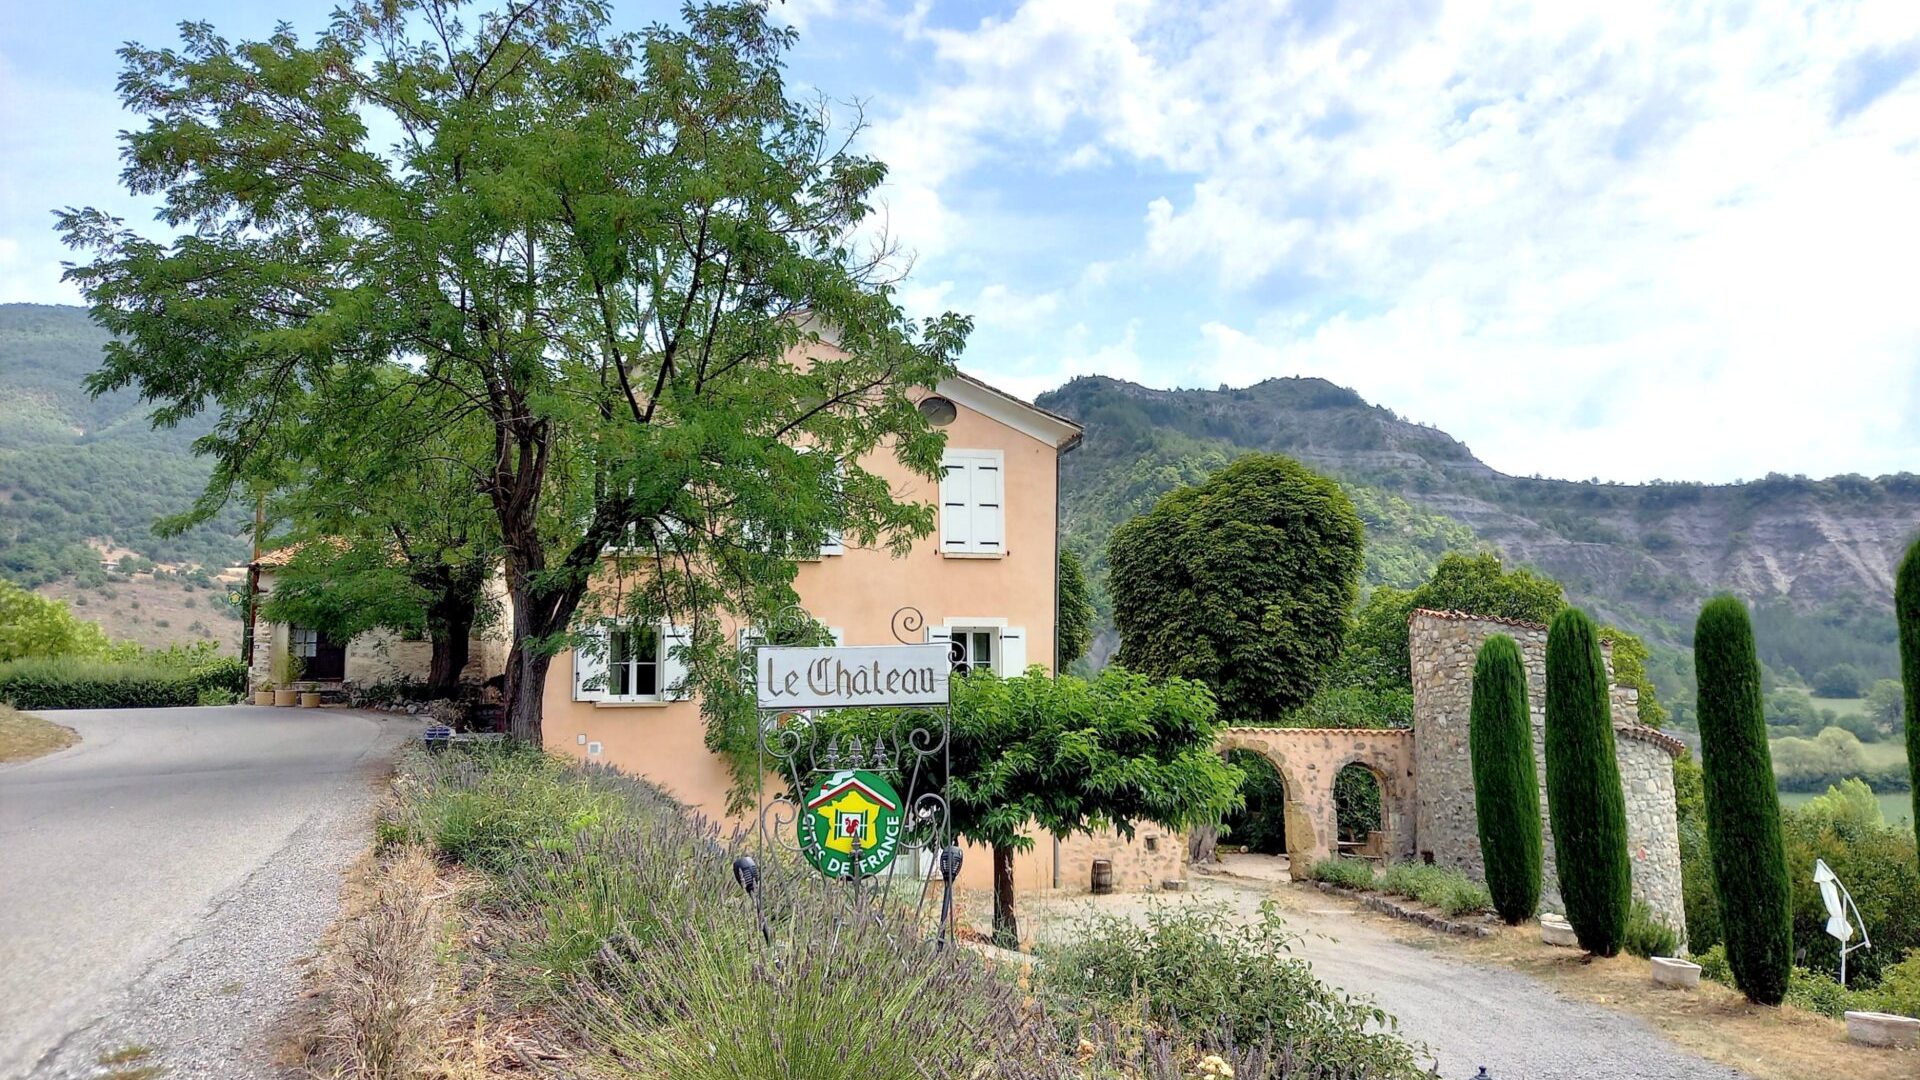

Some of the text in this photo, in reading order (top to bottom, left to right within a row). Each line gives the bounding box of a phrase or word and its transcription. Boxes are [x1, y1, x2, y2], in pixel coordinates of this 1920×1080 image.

[807, 656, 937, 700] Château
[827, 857, 850, 875] DE
[859, 816, 900, 873] FRANCE
